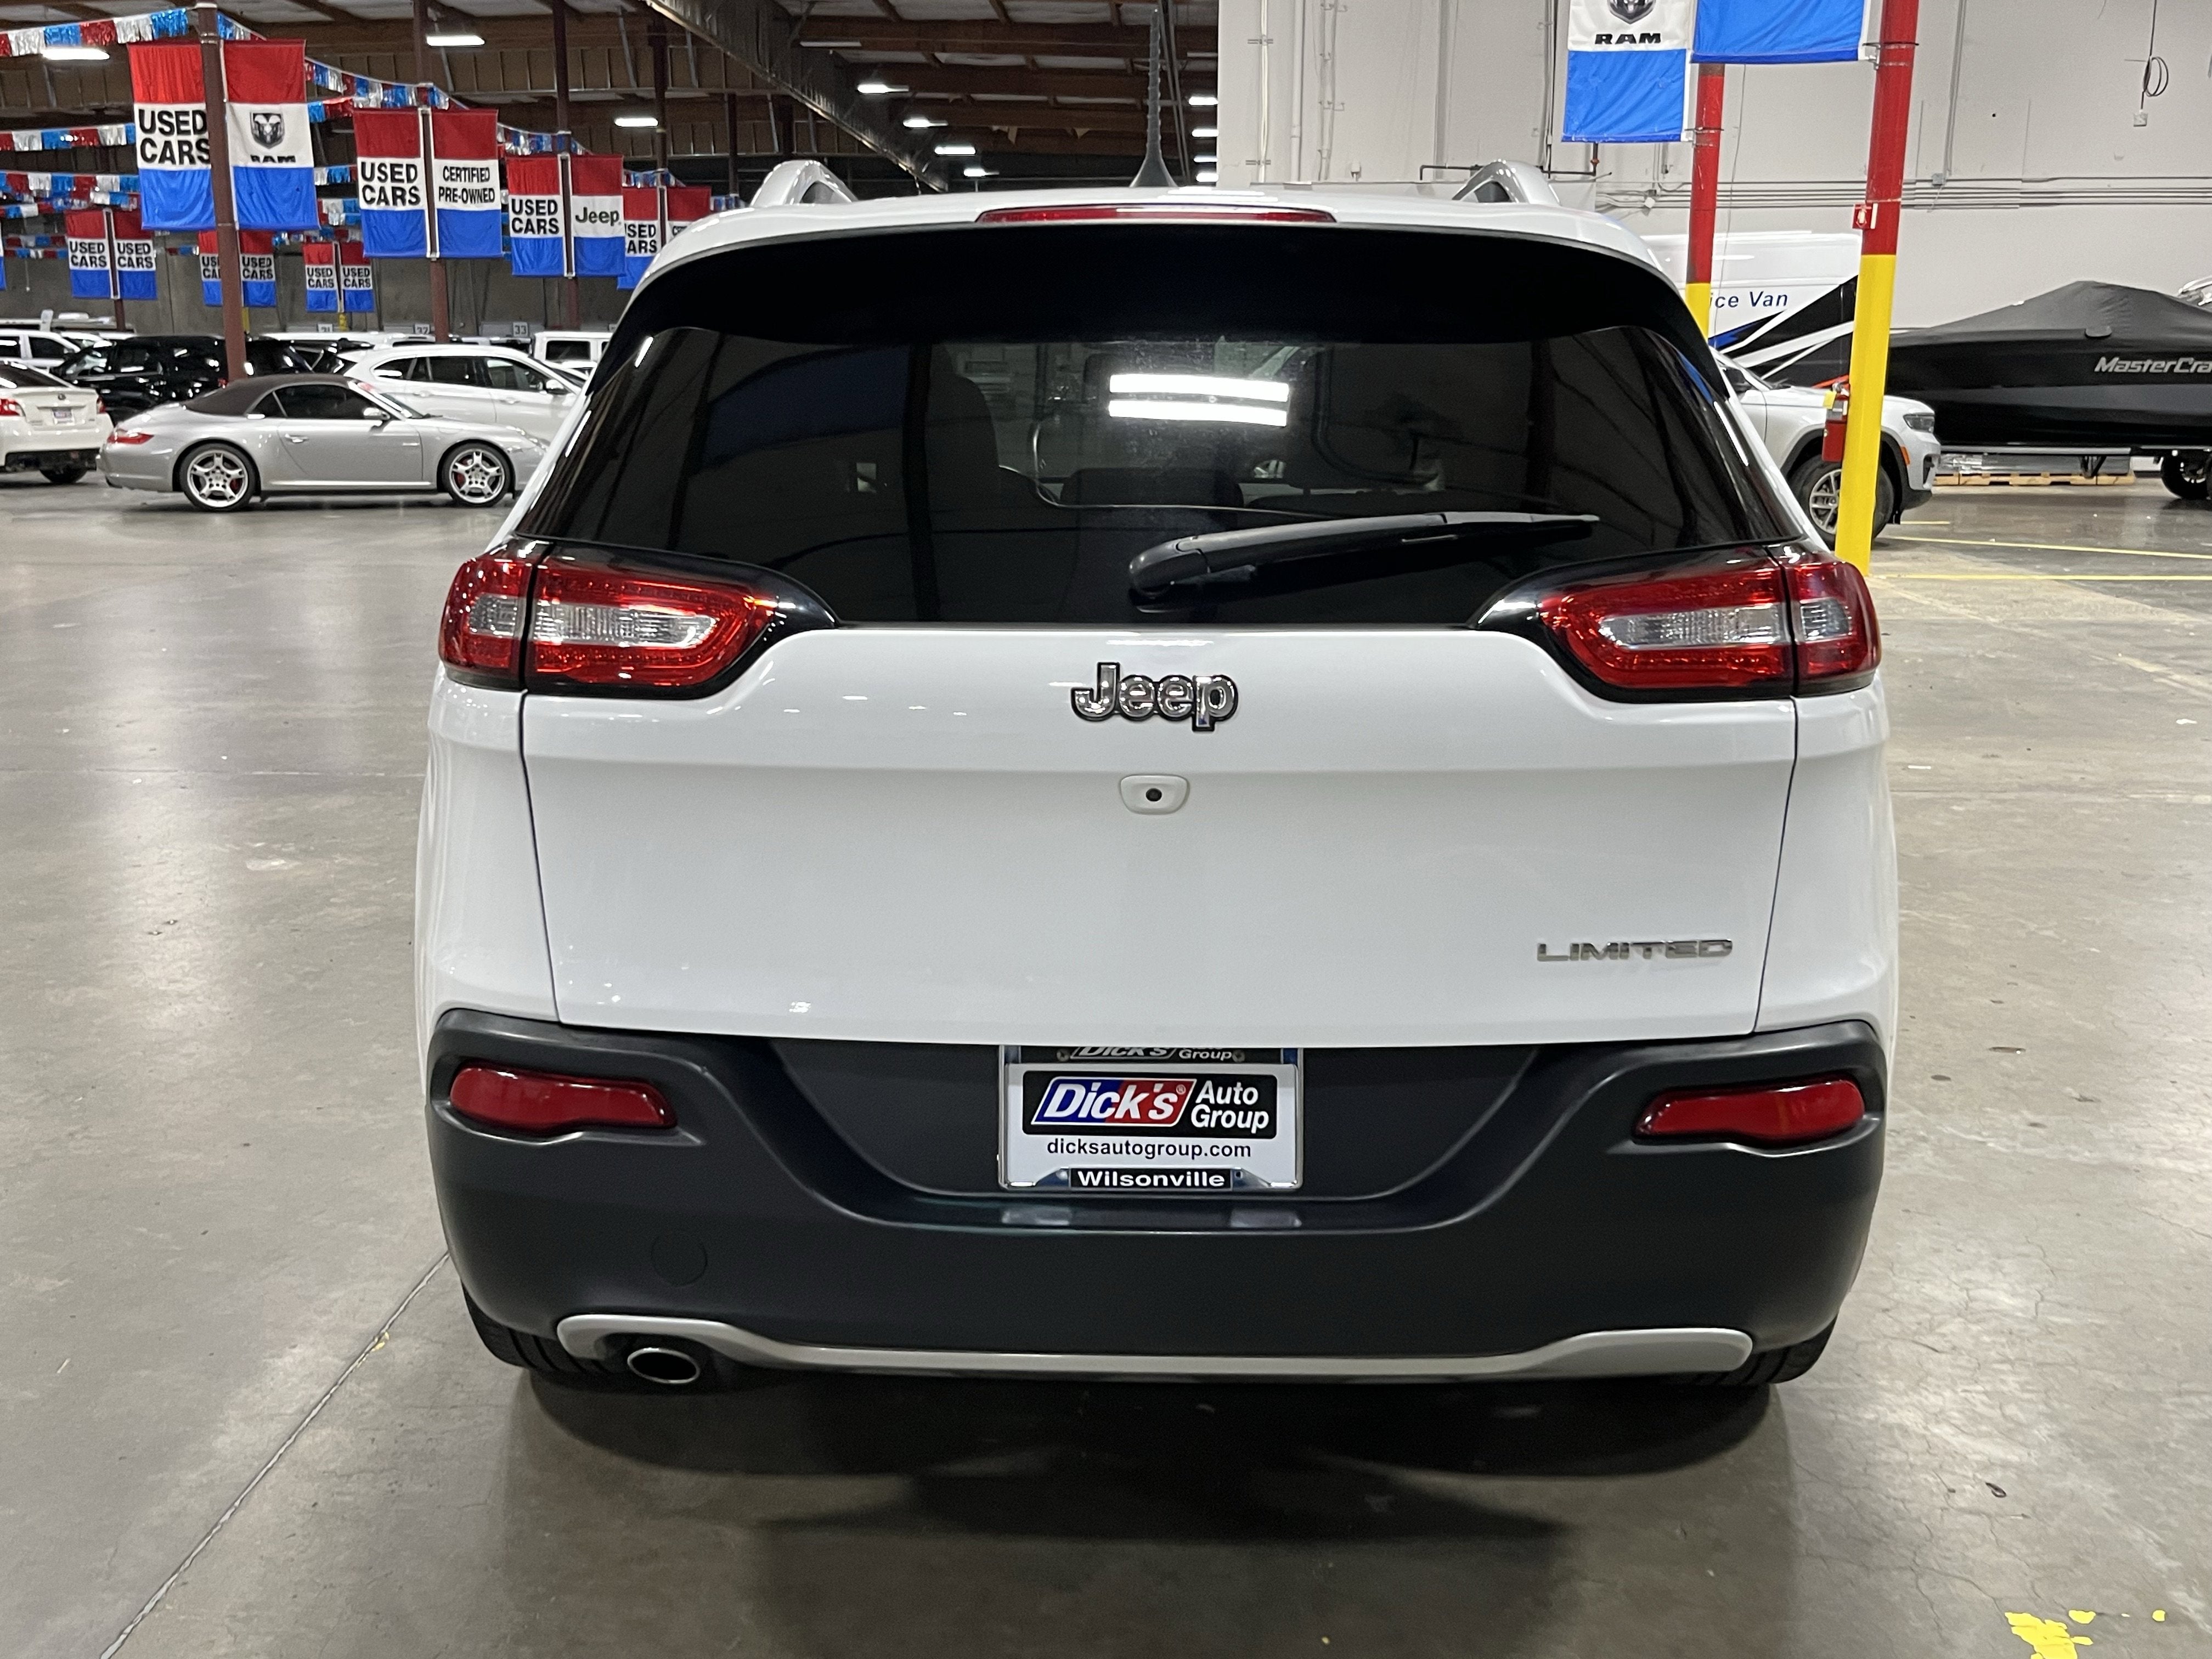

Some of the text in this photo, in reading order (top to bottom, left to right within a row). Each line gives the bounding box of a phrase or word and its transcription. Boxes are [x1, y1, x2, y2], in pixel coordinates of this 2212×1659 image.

[1595, 33, 1661, 45] RAM
[138, 109, 207, 136] USED
[140, 137, 210, 165] CARS
[361, 161, 417, 184] USED
[443, 166, 490, 183] CERTIFIED
[362, 184, 421, 206] CARS
[438, 186, 495, 204] PRE-OWNED
[511, 199, 558, 216] USED
[575, 206, 620, 226] Jeep
[511, 217, 560, 235] CARS
[70, 241, 105, 254] USED
[117, 242, 151, 255] USED
[627, 239, 657, 254] ARS
[71, 254, 107, 268] CARS
[117, 256, 153, 269] CARS
[202, 256, 219, 267] US
[242, 256, 272, 268] USED
[202, 268, 221, 279] CA
[242, 268, 273, 280] CARS
[307, 267, 333, 278] USED
[343, 267, 370, 278] USED
[308, 279, 334, 289] CARS
[343, 278, 371, 289] CARS
[1750, 291, 1788, 307] Van
[515, 325, 527, 335] 33
[2094, 357, 2212, 373] MasterCra
[1070, 662, 1239, 732] Jeep
[1537, 939, 1733, 962] LIMITED
[1178, 1049, 1233, 1061] Group
[1043, 1081, 1178, 1120] Dick's
[1195, 1080, 1259, 1105] Auto
[1190, 1104, 1269, 1134] Group
[1047, 1138, 1251, 1160] dicksautogroup.com
[1077, 1171, 1225, 1188] Wilsonville
